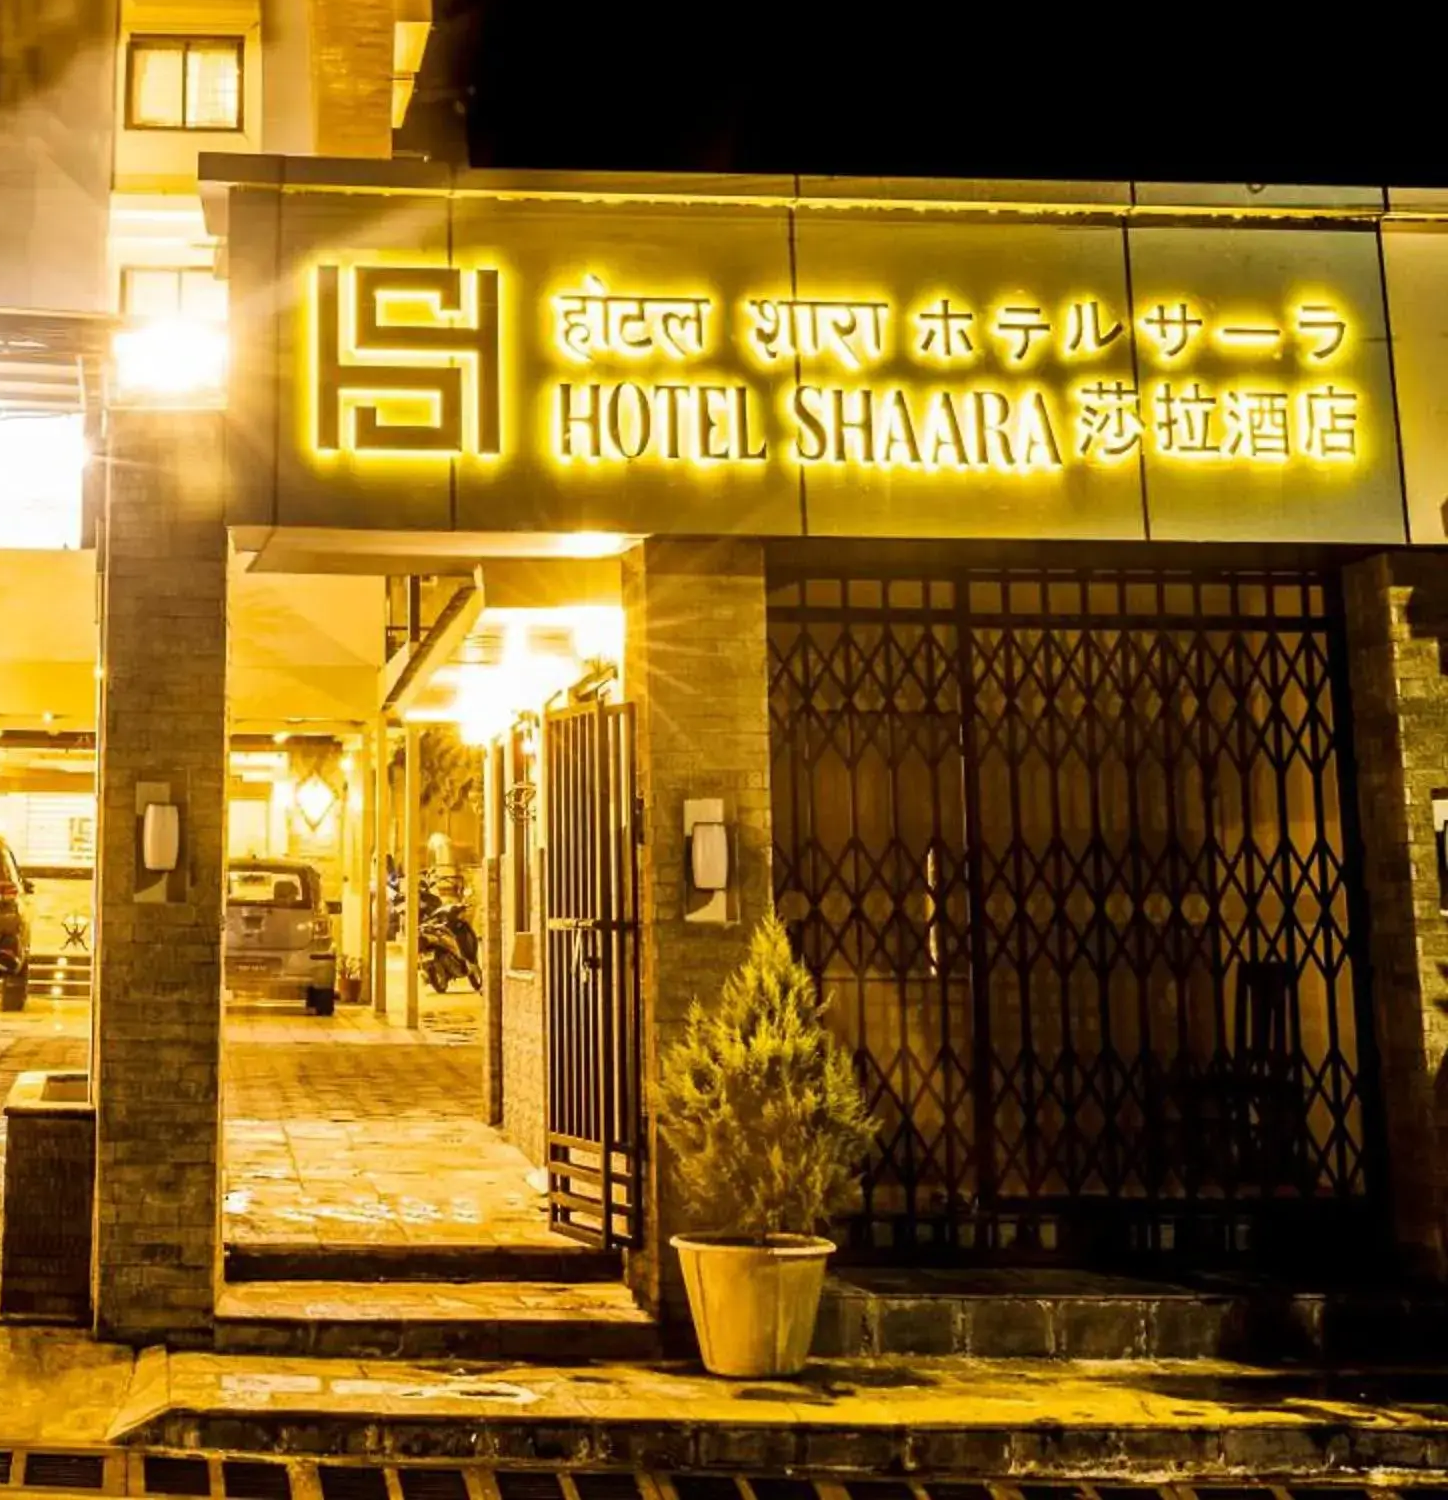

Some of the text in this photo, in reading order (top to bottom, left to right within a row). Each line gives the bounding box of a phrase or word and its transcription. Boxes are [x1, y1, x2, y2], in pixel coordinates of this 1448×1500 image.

[555, 274, 889, 368] होटल शारा
[558, 381, 1063, 465] HOTEL SHAARA
[1078, 380, 1358, 457] 莎拉酒店
